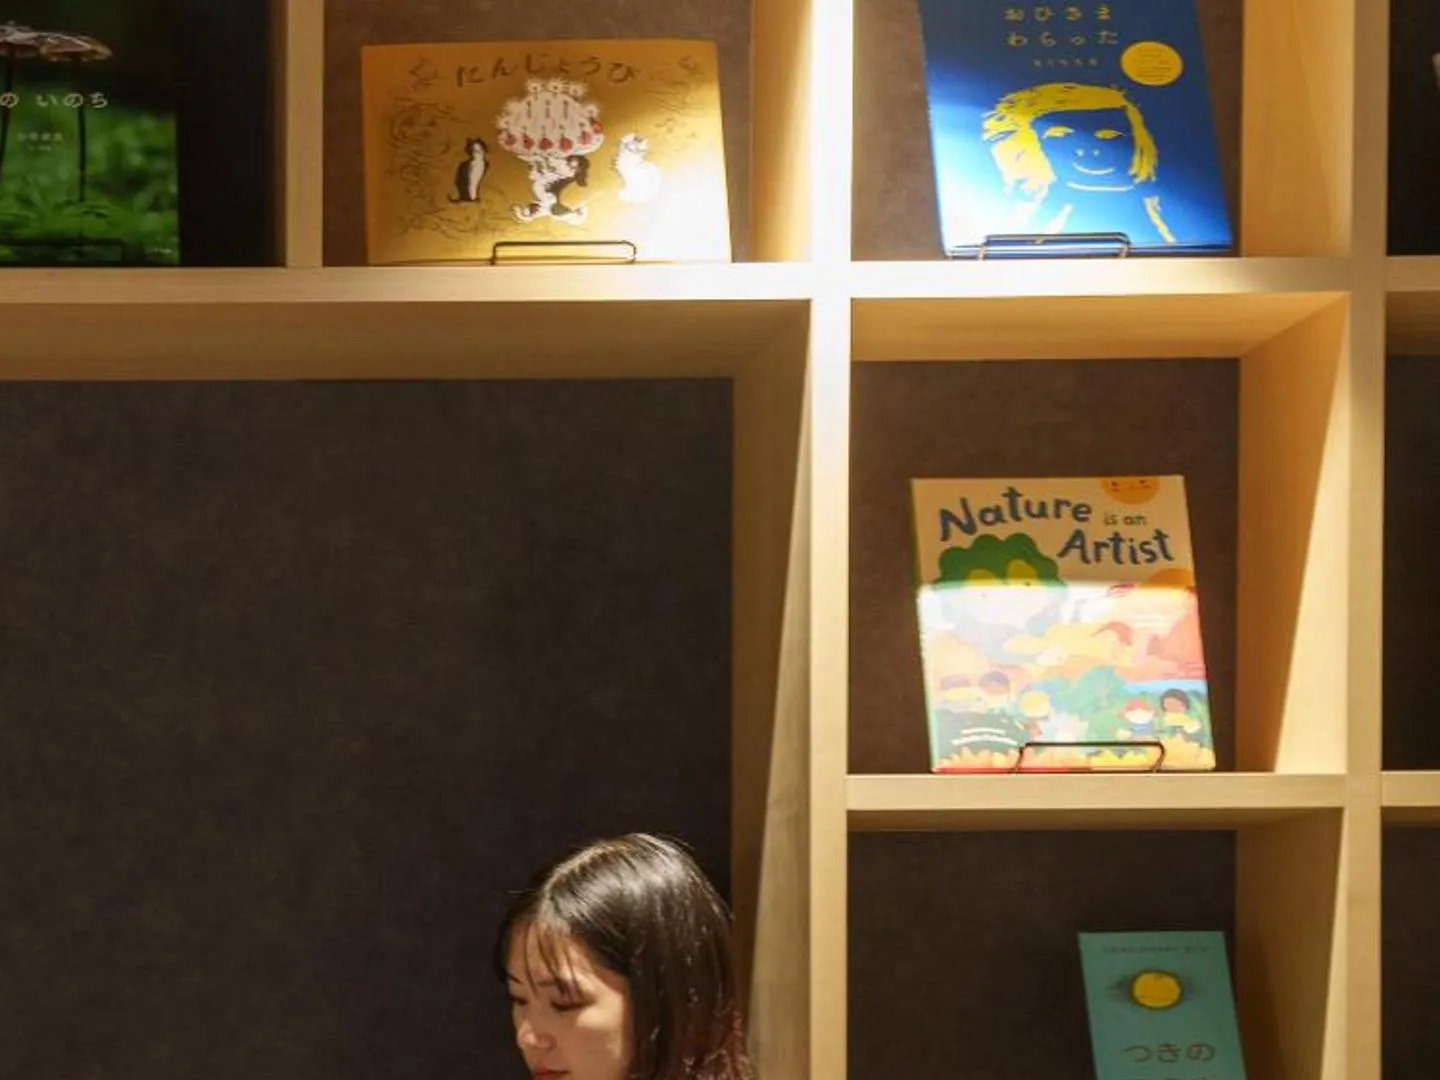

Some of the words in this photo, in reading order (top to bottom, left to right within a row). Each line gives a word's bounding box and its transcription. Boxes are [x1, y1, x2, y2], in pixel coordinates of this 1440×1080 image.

[36, 92, 109, 109] いのち
[939, 486, 1093, 542] Nature
[1103, 511, 1117, 526] is
[1123, 514, 1148, 526] an
[1056, 528, 1175, 565] Artist
[1123, 1042, 1216, 1064] つきの
